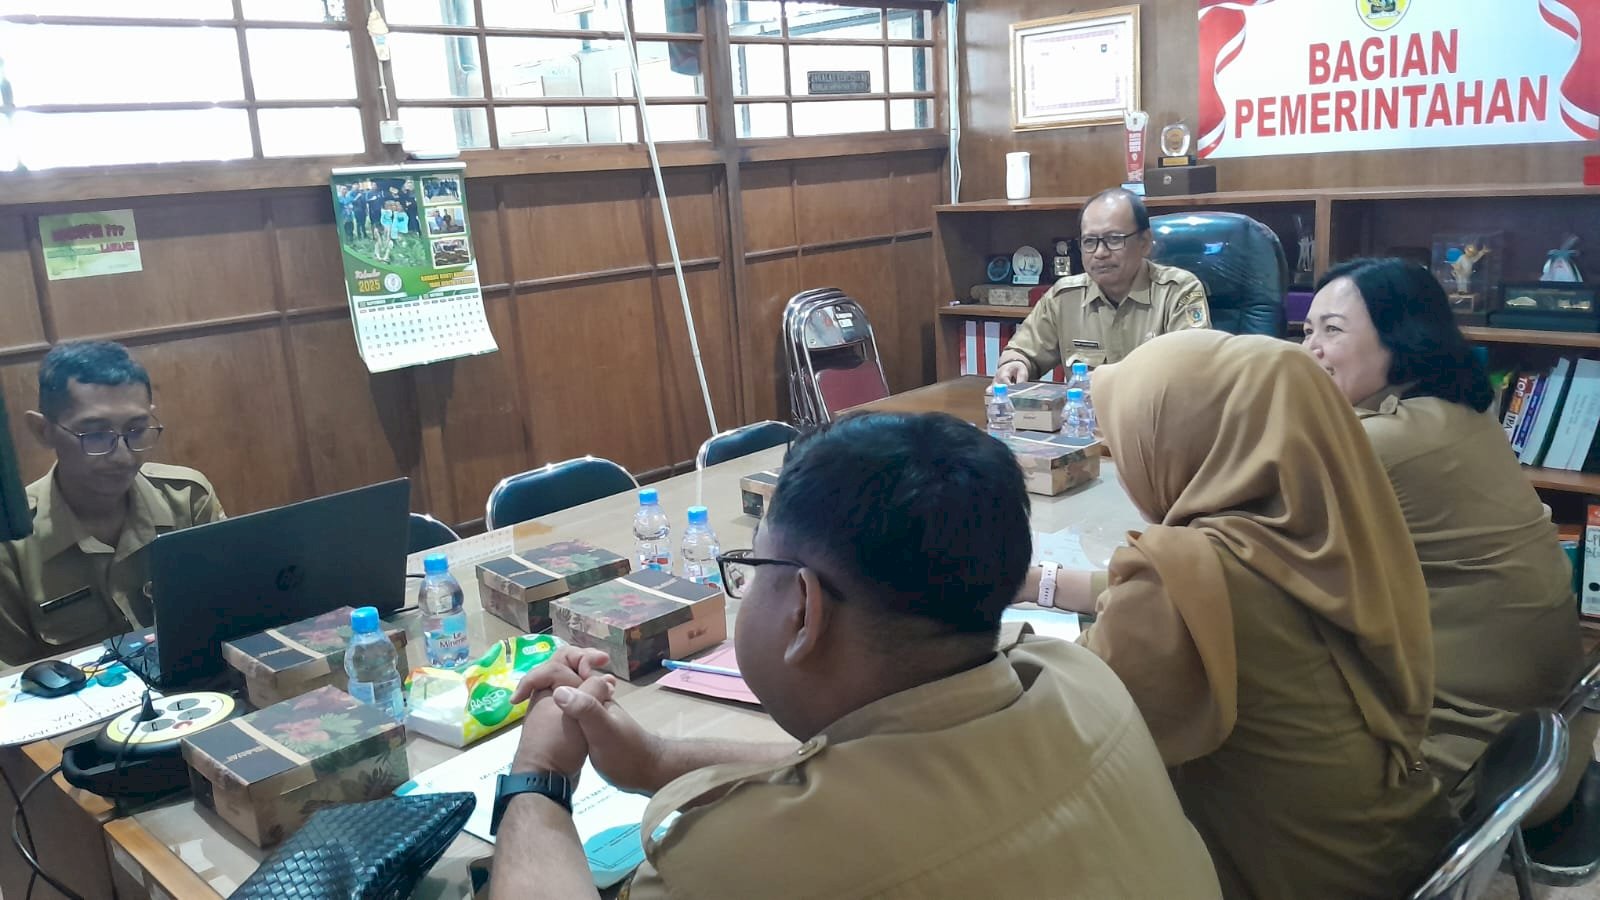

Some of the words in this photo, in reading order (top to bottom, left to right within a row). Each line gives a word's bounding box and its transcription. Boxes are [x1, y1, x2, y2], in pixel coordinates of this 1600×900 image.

[1309, 29, 1458, 85] BAGIAN
[1235, 75, 1548, 139] PEMERINTAHAN
[359, 279, 381, 292] 2025
[1516, 377, 1528, 397] TOP
[439, 638, 467, 648] Miner
